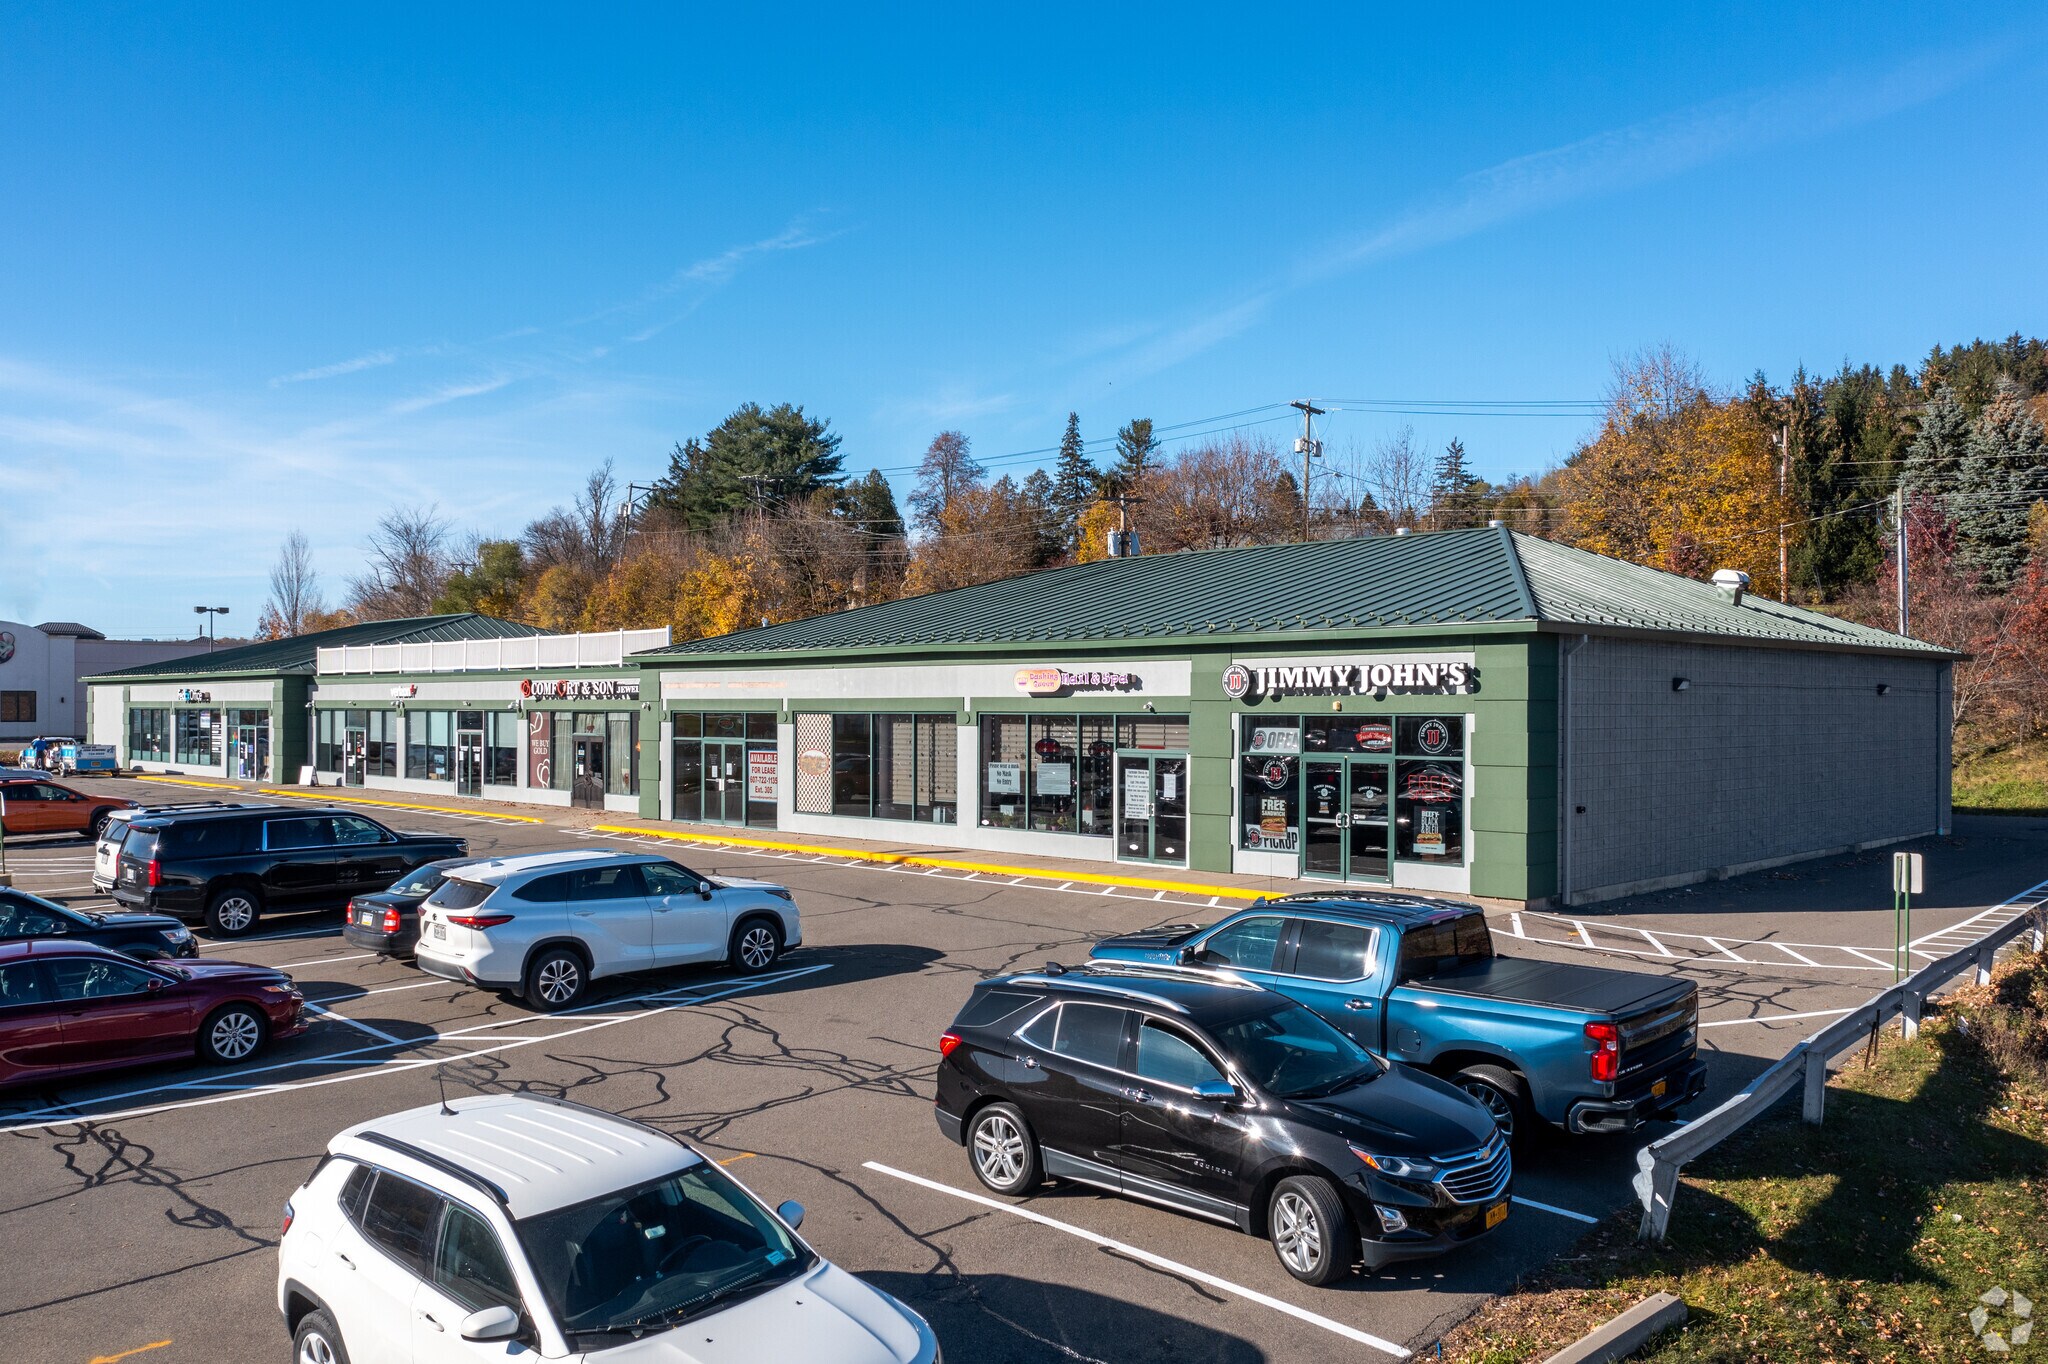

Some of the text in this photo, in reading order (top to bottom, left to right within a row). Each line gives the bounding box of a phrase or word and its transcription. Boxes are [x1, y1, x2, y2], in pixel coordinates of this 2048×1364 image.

[1029, 672, 1059, 681] Dashing
[1061, 672, 1129, 687] Nail & Spa
[1229, 674, 1242, 690] JJ
[1256, 665, 1352, 695] JIMMY
[1358, 662, 1466, 693] JOHN'S
[581, 681, 591, 695] &
[591, 681, 614, 695] SON
[531, 739, 549, 748] WE BUY
[1426, 729, 1440, 745] JJ
[533, 747, 548, 755] GOLD
[750, 753, 778, 763] AVAILABLE
[751, 766, 776, 774] FOR LEASE
[1269, 767, 1282, 782] JJ
[755, 785, 764, 793] Ext.
[1002, 778, 1012, 786] Entry
[1407, 774, 1452, 791] FREE
[1261, 798, 1286, 811] FREE
[1263, 832, 1298, 850] PICKUP
[1193, 1160, 1233, 1177] EQUINOX
